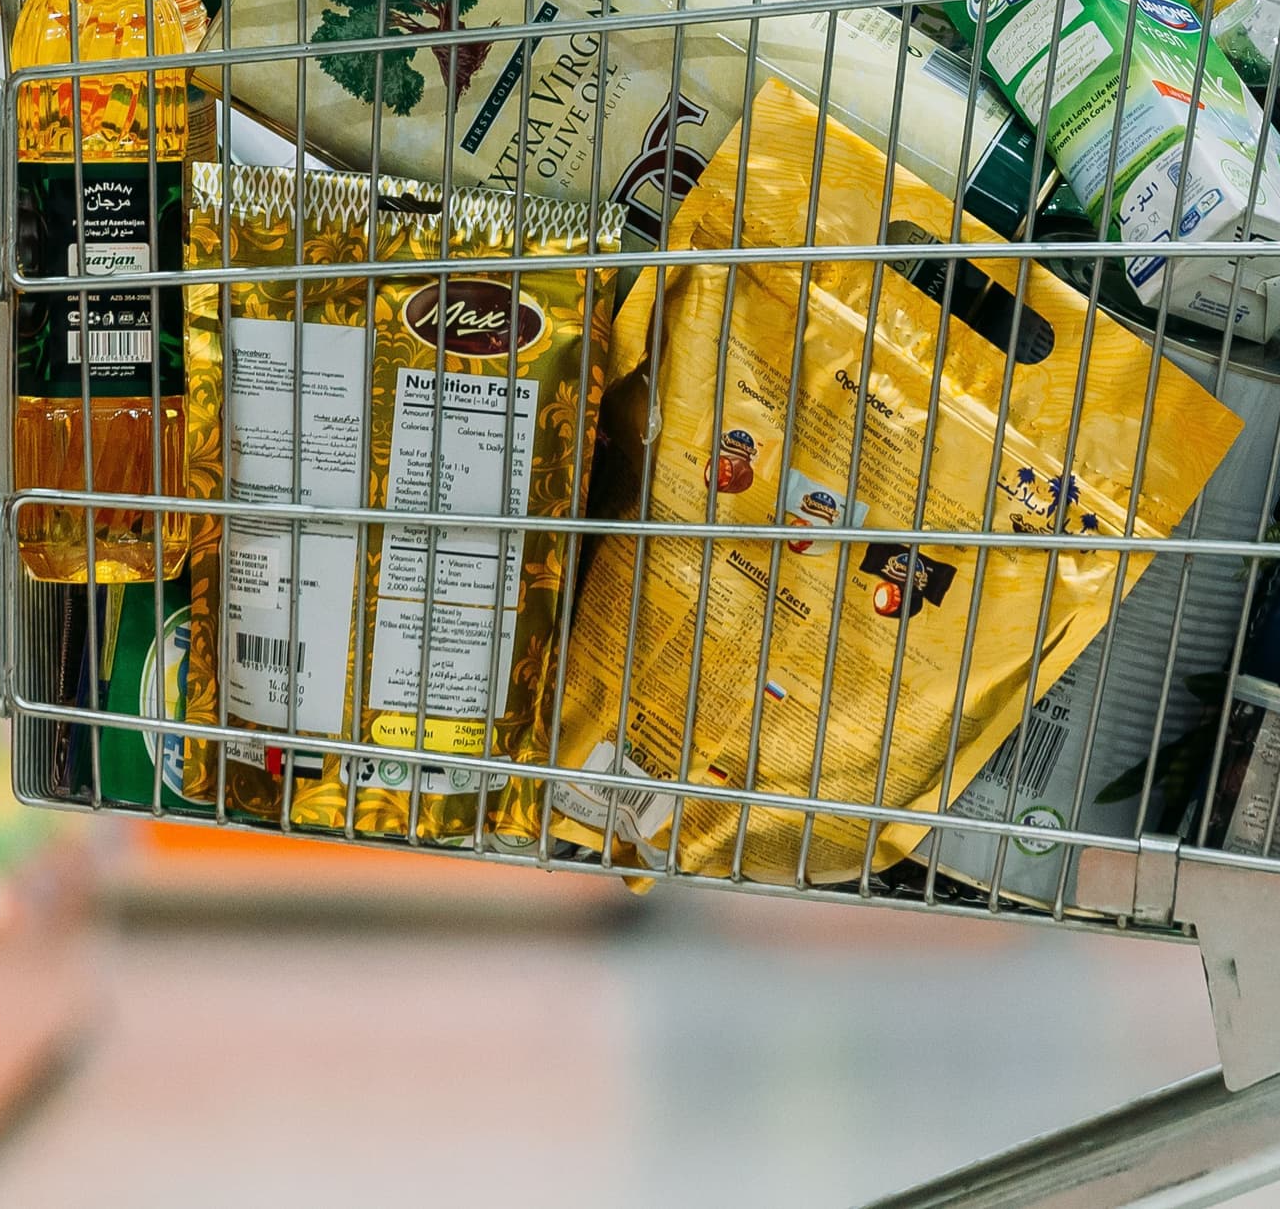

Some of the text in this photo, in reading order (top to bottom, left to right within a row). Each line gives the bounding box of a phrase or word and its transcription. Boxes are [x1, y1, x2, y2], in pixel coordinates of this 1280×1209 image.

[1136, 19, 1188, 50] Fresh
[466, 71, 515, 150] FIRST COLD
[1047, 128, 1063, 144] Low
[1059, 116, 1074, 131] Fat
[1071, 99, 1093, 121] Long
[1090, 86, 1108, 103] Life
[1104, 74, 1122, 91] Mil
[1067, 114, 1090, 136] Fresh
[1087, 96, 1112, 119] Cow's
[560, 150, 588, 187] RICH
[602, 71, 633, 120] RUITY
[537, 104, 590, 179] OLIVE
[476, 117, 554, 192] XTRA
[84, 182, 133, 197] MARJAN
[86, 193, 131, 212] مرجان
[73, 219, 101, 227] Pduct
[109, 219, 145, 227] Azerbaijan
[416, 301, 507, 331] Max
[727, 349, 755, 372] corners
[761, 373, 775, 386] the
[406, 375, 530, 399] Nutition Fats
[735, 378, 776, 412] Chocodate
[833, 368, 895, 419] Chocdate
[404, 390, 430, 401] Serving
[454, 395, 472, 403] Piece
[729, 335, 748, 352] hose
[746, 349, 769, 368] dream
[767, 364, 783, 379] was
[869, 441, 889, 458] treat
[886, 453, 903, 468] that
[403, 409, 468, 423] Amount Serving
[865, 413, 893, 436] created
[401, 422, 429, 431] Calories
[458, 428, 485, 437] Calories
[488, 430, 503, 438] from
[863, 422, 883, 440] awaz
[400, 448, 415, 456] Total
[416, 450, 427, 458] Fat
[486, 444, 504, 454] Daily
[798, 440, 836, 471] recognized
[442, 461, 452, 469] Fat
[396, 487, 421, 496] Sodium
[395, 497, 428, 506] Potassium
[391, 534, 415, 544] Protein
[389, 564, 462, 577] Calcium Iron
[390, 554, 482, 570] Vitamin A Vitamin C
[437, 578, 458, 587] Values
[474, 580, 495, 590] based
[850, 575, 869, 591] Dark
[777, 585, 814, 616] Facts
[1052, 705, 1069, 721] gr.
[379, 725, 396, 735] Net
[400, 726, 433, 738] Weht
[226, 744, 241, 757] ade
